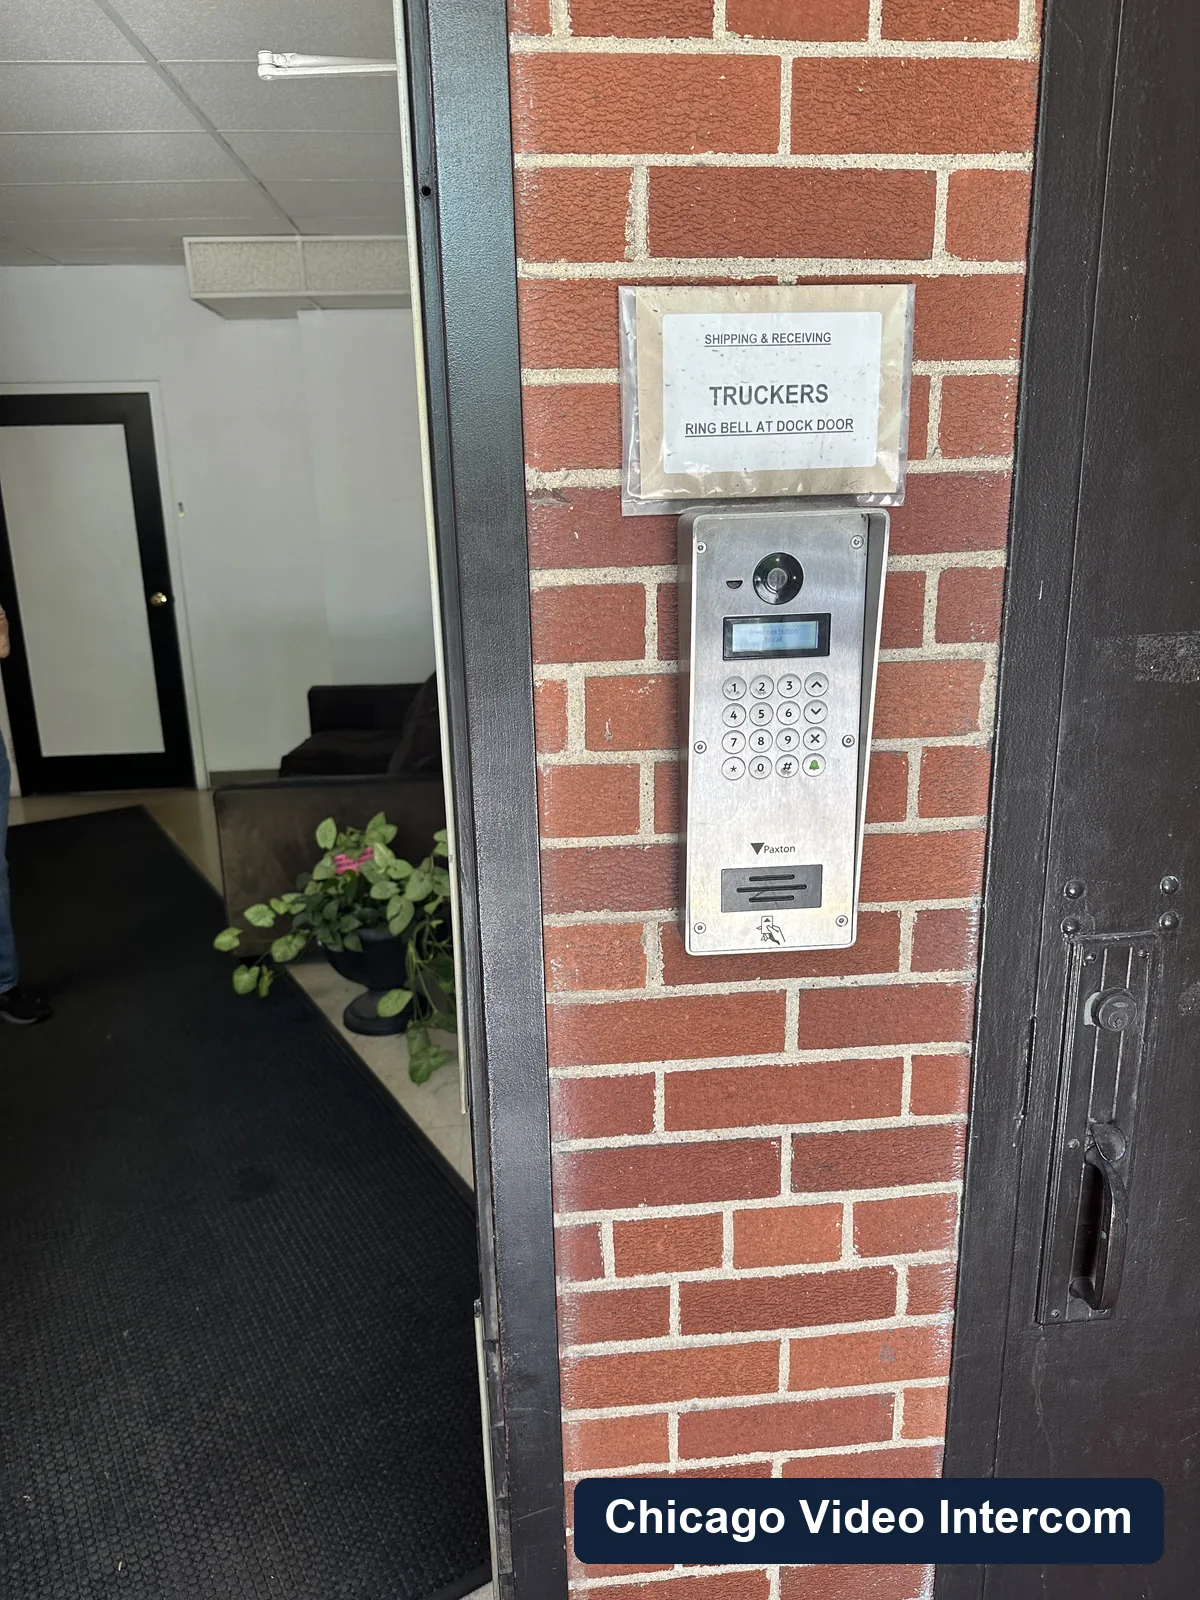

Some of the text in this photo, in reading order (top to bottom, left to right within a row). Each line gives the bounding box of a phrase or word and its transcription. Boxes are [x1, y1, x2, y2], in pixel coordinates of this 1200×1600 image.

[704, 332, 832, 345] SHIPPING & RECEIVING
[709, 383, 829, 406] TRUCKERS
[685, 418, 854, 435] RING BELL AT DOCK DOOR
[778, 627, 799, 635] button
[764, 844, 796, 854] Paxton
